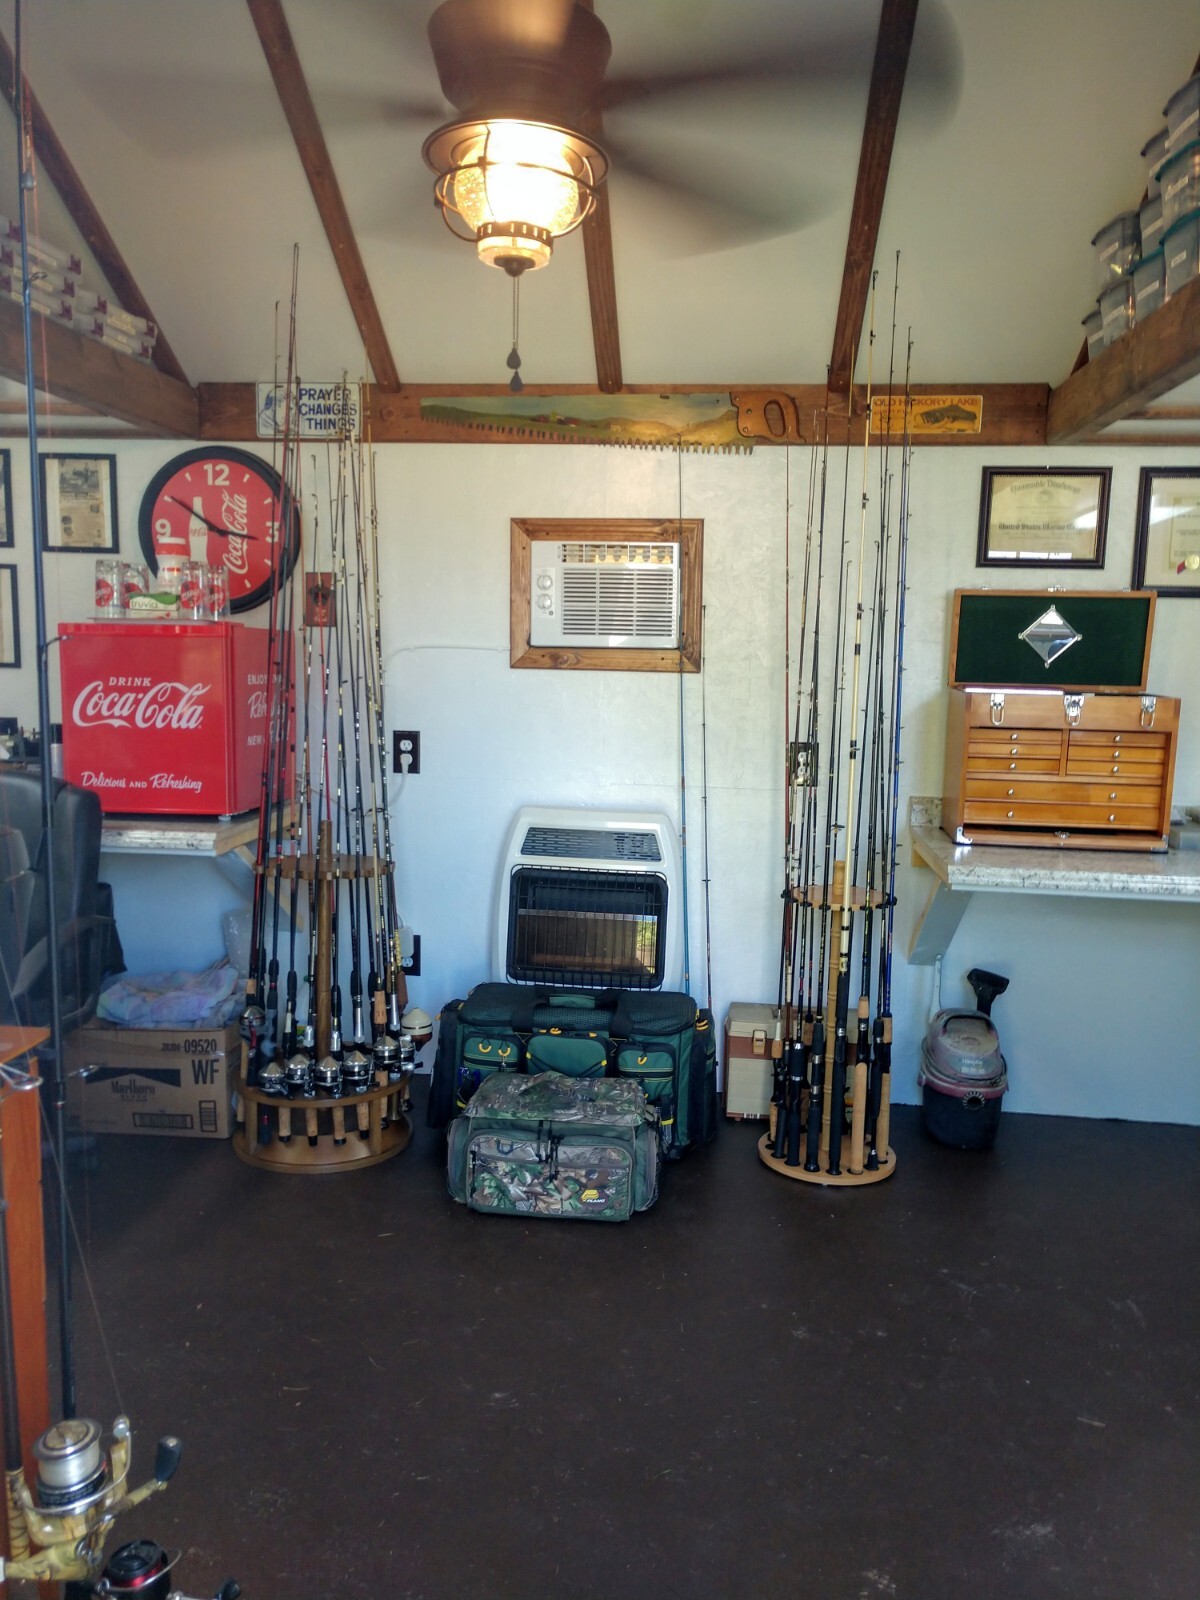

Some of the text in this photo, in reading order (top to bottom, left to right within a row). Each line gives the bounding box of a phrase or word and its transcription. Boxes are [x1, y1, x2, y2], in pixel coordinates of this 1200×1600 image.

[299, 388, 351, 401] PRAYER
[899, 397, 949, 406] HKORY
[298, 403, 357, 416] CHANGES
[305, 418, 355, 431] THINGS
[203, 463, 230, 486] 12
[108, 676, 152, 687] DRINK
[72, 681, 212, 729] Coca-Cola
[247, 736, 263, 746] NEW
[81, 771, 126, 788] Delicious
[150, 773, 202, 793] Refreshing
[184, 1038, 217, 1053] 09520
[191, 1058, 219, 1085] WF
